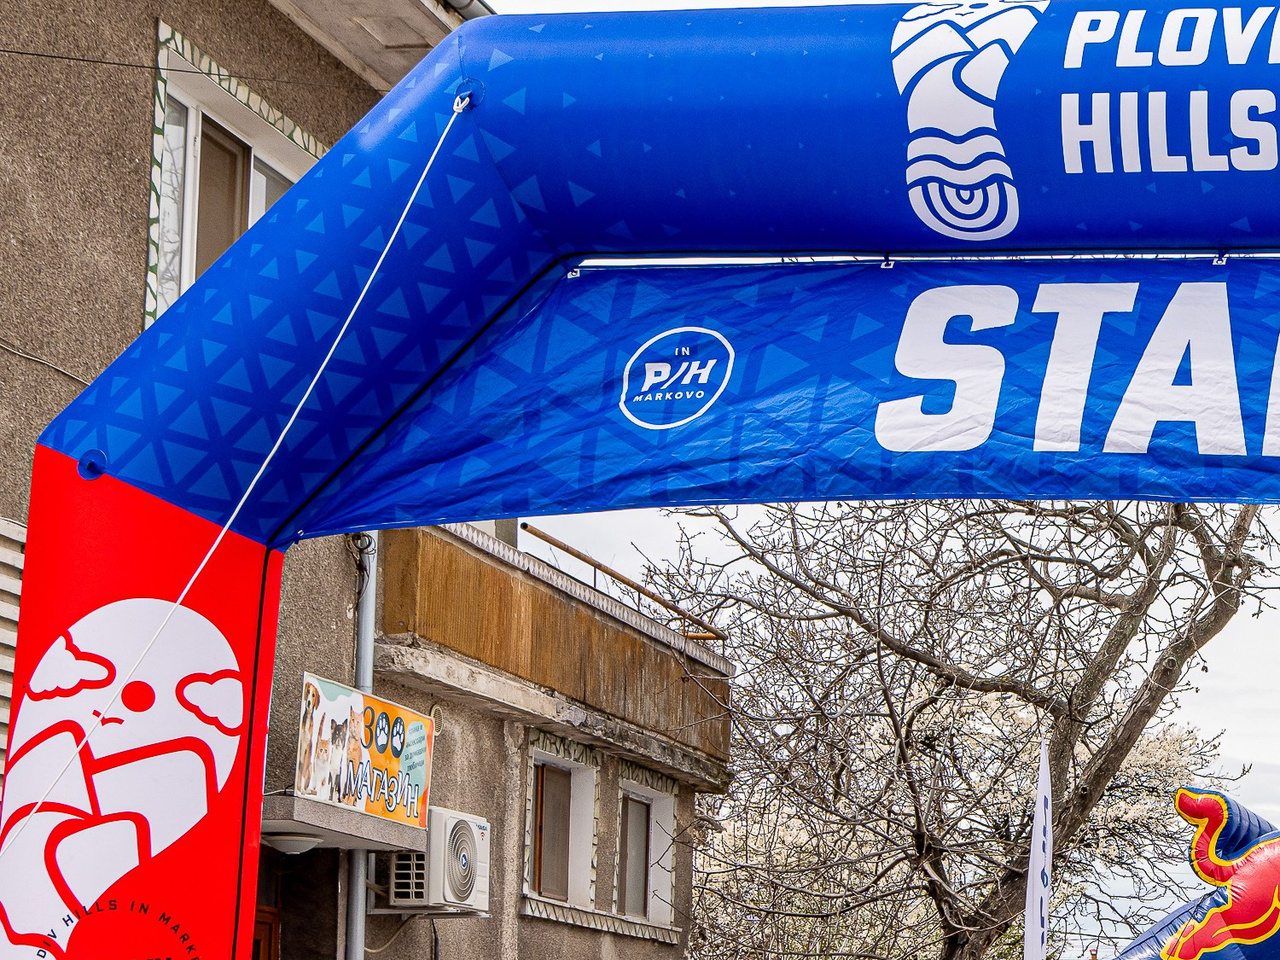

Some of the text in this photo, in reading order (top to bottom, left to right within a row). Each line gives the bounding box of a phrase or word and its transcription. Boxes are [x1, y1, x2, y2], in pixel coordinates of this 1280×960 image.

[1062, 90, 1278, 173] HILLS
[675, 346, 690, 356] IN
[641, 359, 717, 392] P/H
[633, 390, 704, 402] MARKOVO
[345, 760, 420, 818] МАГАЗИН
[62, 900, 118, 927] HILLS
[130, 901, 149, 914] IN
